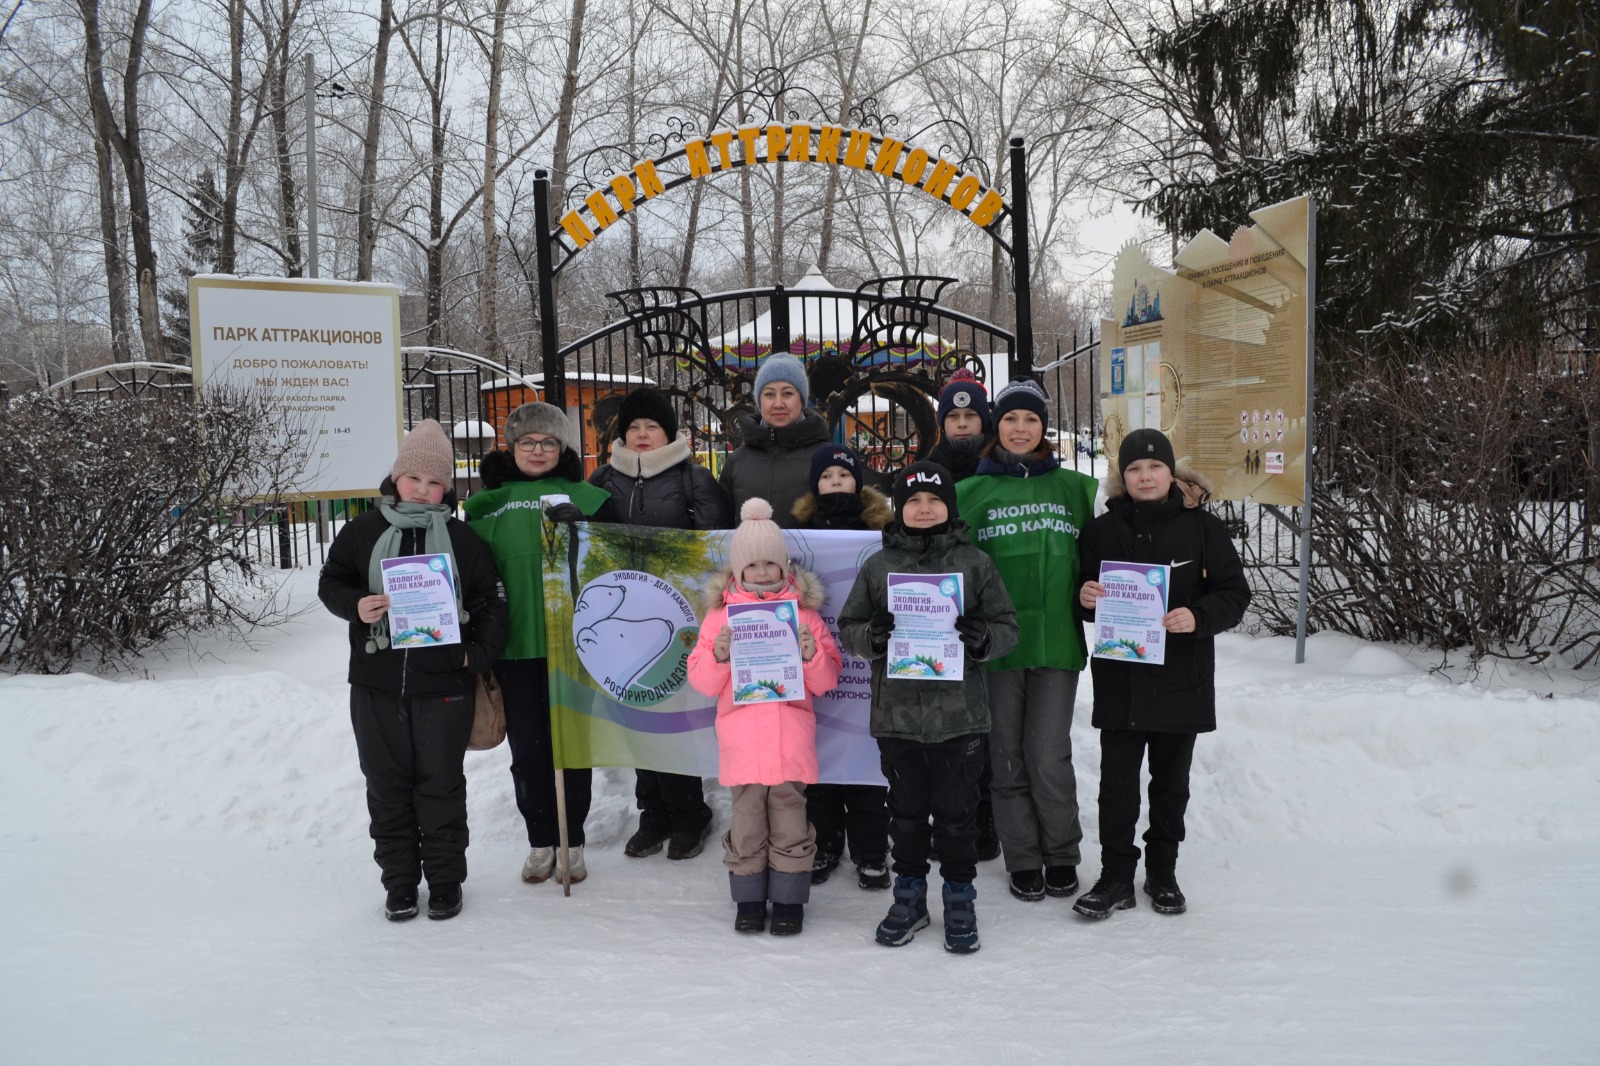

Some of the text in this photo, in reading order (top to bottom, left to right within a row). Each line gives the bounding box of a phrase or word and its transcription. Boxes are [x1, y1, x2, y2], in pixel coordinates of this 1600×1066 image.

[559, 123, 1003, 249] ПАРК АТТРАКЦИОНОВ
[1188, 269, 1210, 280] ПРАВИЛА
[1211, 259, 1244, 274] ПОСЕЩЕНИЯ
[1249, 248, 1285, 264] ПОВЕДЕНИЯ
[1206, 278, 1223, 288] ПАРКЕ
[1223, 266, 1267, 283] АТТРАКЦИОНОВ
[213, 326, 383, 345] ПАРК АТТРАКЦИОНОВ
[233, 359, 369, 370] ДОБРО ПОЖАЛОВАТЬ!
[255, 377, 349, 388] МЫ ЖДЕМ ВАС!
[833, 451, 854, 466] FILA
[906, 472, 942, 487] FILA
[987, 502, 1066, 521] ЭКОЛОГИЯ
[977, 523, 1018, 542] ДЕЛО
[388, 579, 441, 592] ДЕЛО КАЖДОГО
[613, 572, 648, 582] ЭКОЛОГИЯ
[654, 581, 672, 594] ДЕЛО
[671, 590, 694, 622] КАЖДОГО
[1122, 591, 1155, 601] КАЖДОГО
[893, 604, 951, 614] ДЕЛО КАЖДОГО
[733, 629, 788, 642] ДЕЛО КАЖДОГО
